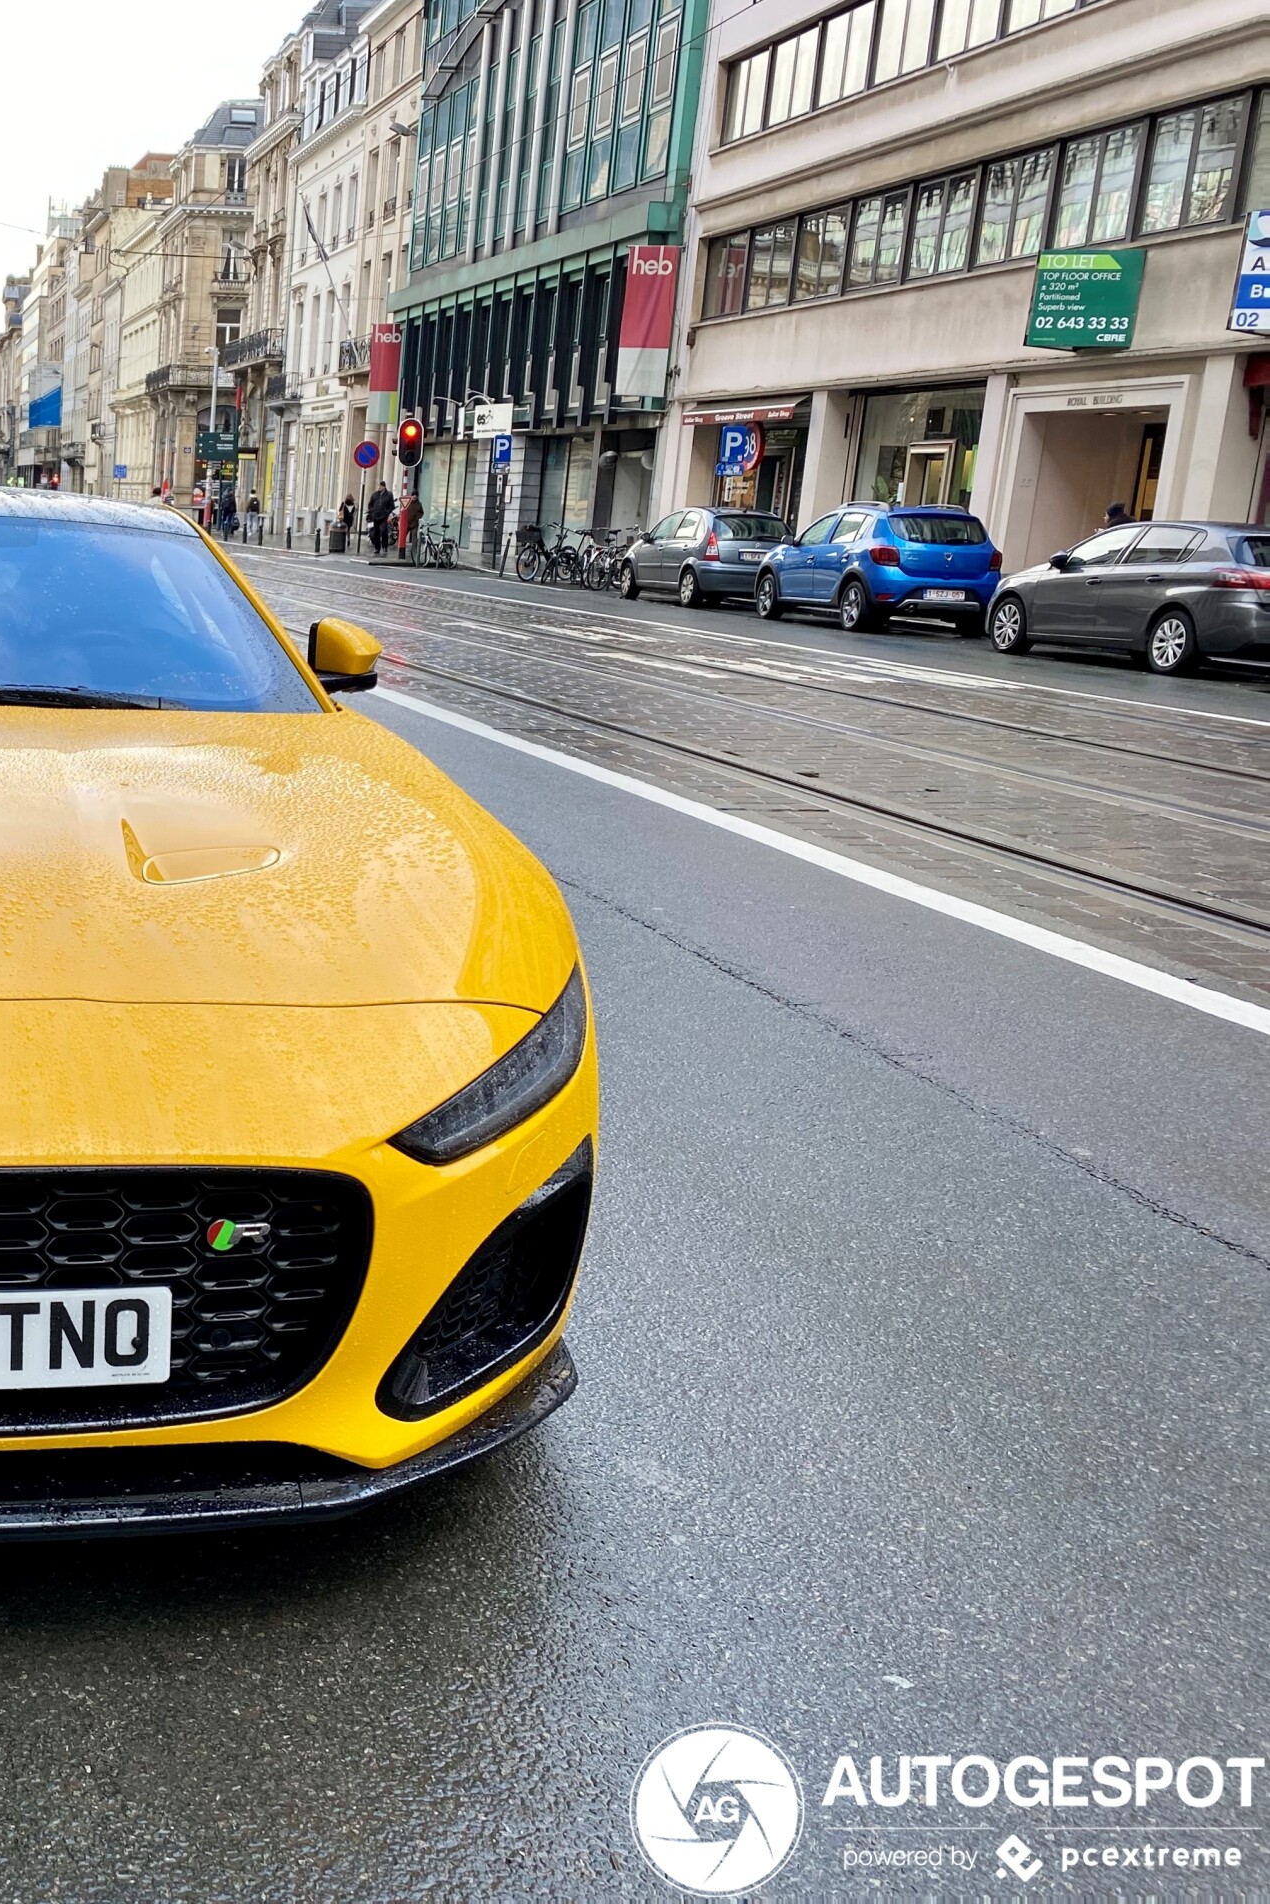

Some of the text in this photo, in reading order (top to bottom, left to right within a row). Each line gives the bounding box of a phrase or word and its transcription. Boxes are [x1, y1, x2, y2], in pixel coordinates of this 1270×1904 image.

[632, 245, 673, 276] heb
[1046, 254, 1099, 269] TO LET
[1043, 272, 1122, 281] TOP FLOOR OFFICE
[1049, 282, 1066, 291] 320
[1039, 292, 1081, 301] Partitioned
[1037, 302, 1086, 313] Superb view
[1035, 316, 1129, 330] 02 643 33 33
[1236, 312, 1259, 327] 02
[375, 323, 402, 343] heb
[1096, 333, 1127, 342] CBRE
[1067, 394, 1123, 407] ROYAL BUILDING
[714, 412, 755, 422] Groove Street
[495, 438, 510, 459] P
[724, 431, 743, 458] P
